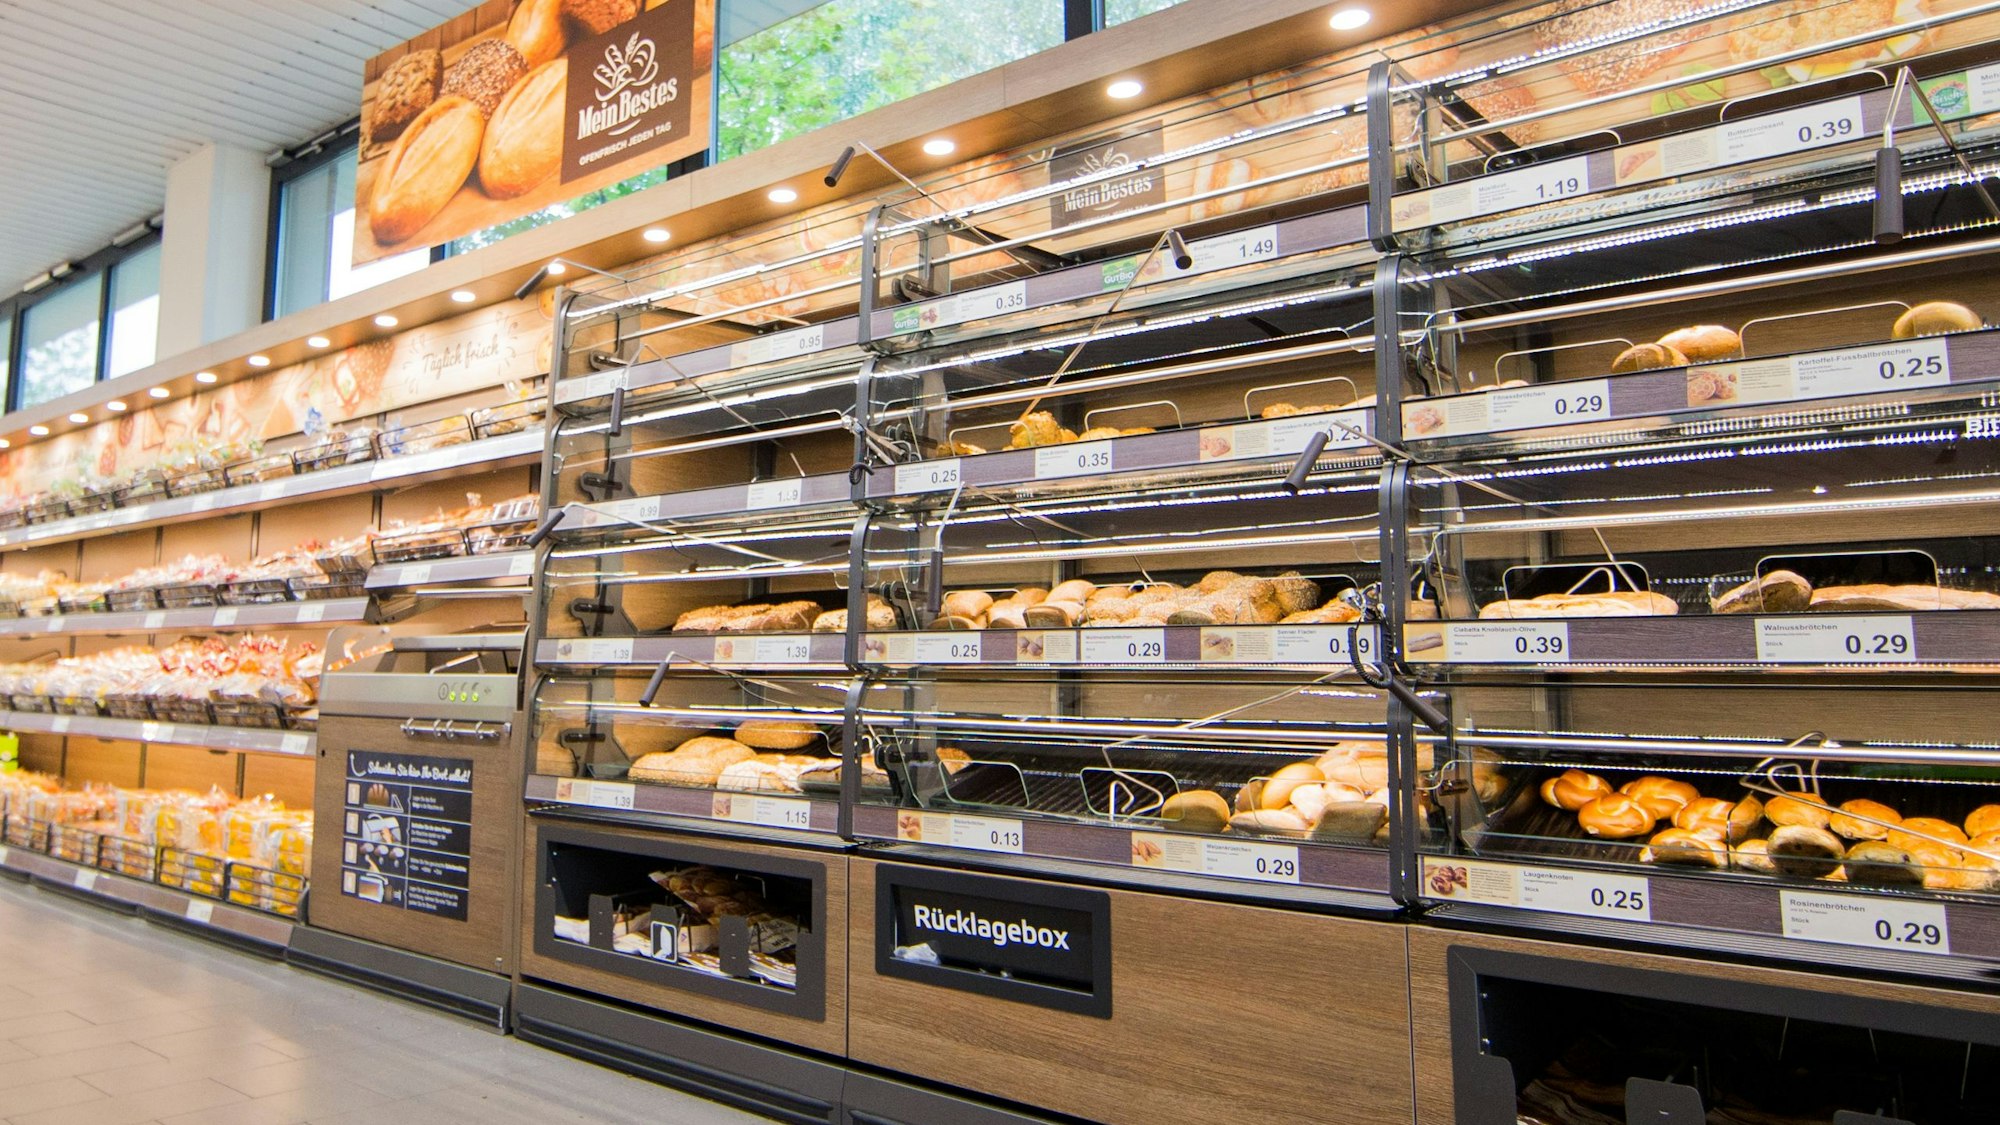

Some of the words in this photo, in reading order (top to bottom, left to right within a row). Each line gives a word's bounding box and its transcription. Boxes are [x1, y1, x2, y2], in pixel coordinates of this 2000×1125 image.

[1798, 118, 1853, 142] 0.39
[579, 139, 627, 165] OFENFRISCH
[628, 128, 655, 147] JEDEN
[655, 121, 672, 136] TAG
[1535, 178, 1579, 198] 1.19
[1239, 239, 1273, 258] 1.49
[996, 293, 1023, 310] 0.35
[799, 334, 821, 350] 0.95
[422, 343, 462, 380] Täglich
[465, 334, 499, 369] frisch
[1798, 348, 1912, 366] Kartoffel-Fussballbrötchen
[1878, 355, 1942, 380] 0.25
[1554, 395, 1603, 415] 0.29
[1078, 453, 1109, 468] 0.35
[931, 469, 957, 484] 0.25
[640, 505, 658, 518] 0.99
[1763, 623, 1838, 631] Walnussbrötchen
[786, 646, 807, 658] 1.39
[951, 644, 978, 657] 0.25
[1128, 642, 1161, 657] 0.29
[1329, 638, 1369, 654] 0.9
[1515, 636, 1563, 654] 0.39
[1845, 634, 1908, 654] 0.29
[614, 649, 629, 660] 1.39
[367, 760, 396, 775] Schneiden
[397, 763, 408, 777] Sie
[408, 763, 421, 778] hier
[421, 765, 432, 779] Ihr
[432, 765, 448, 781] Brot
[614, 795, 631, 807] 1.39
[785, 810, 807, 824] 1.15
[991, 830, 1019, 847] 0.13
[1256, 857, 1294, 876] 0.29
[1523, 871, 1574, 881] Laugenknoten
[1590, 887, 1644, 911] 0.25
[1790, 899, 1866, 912] Rosinenbrötchen
[914, 904, 1070, 950] Rücklagebox
[1791, 916, 1809, 924] Stück
[1875, 919, 1941, 945] 0.29
